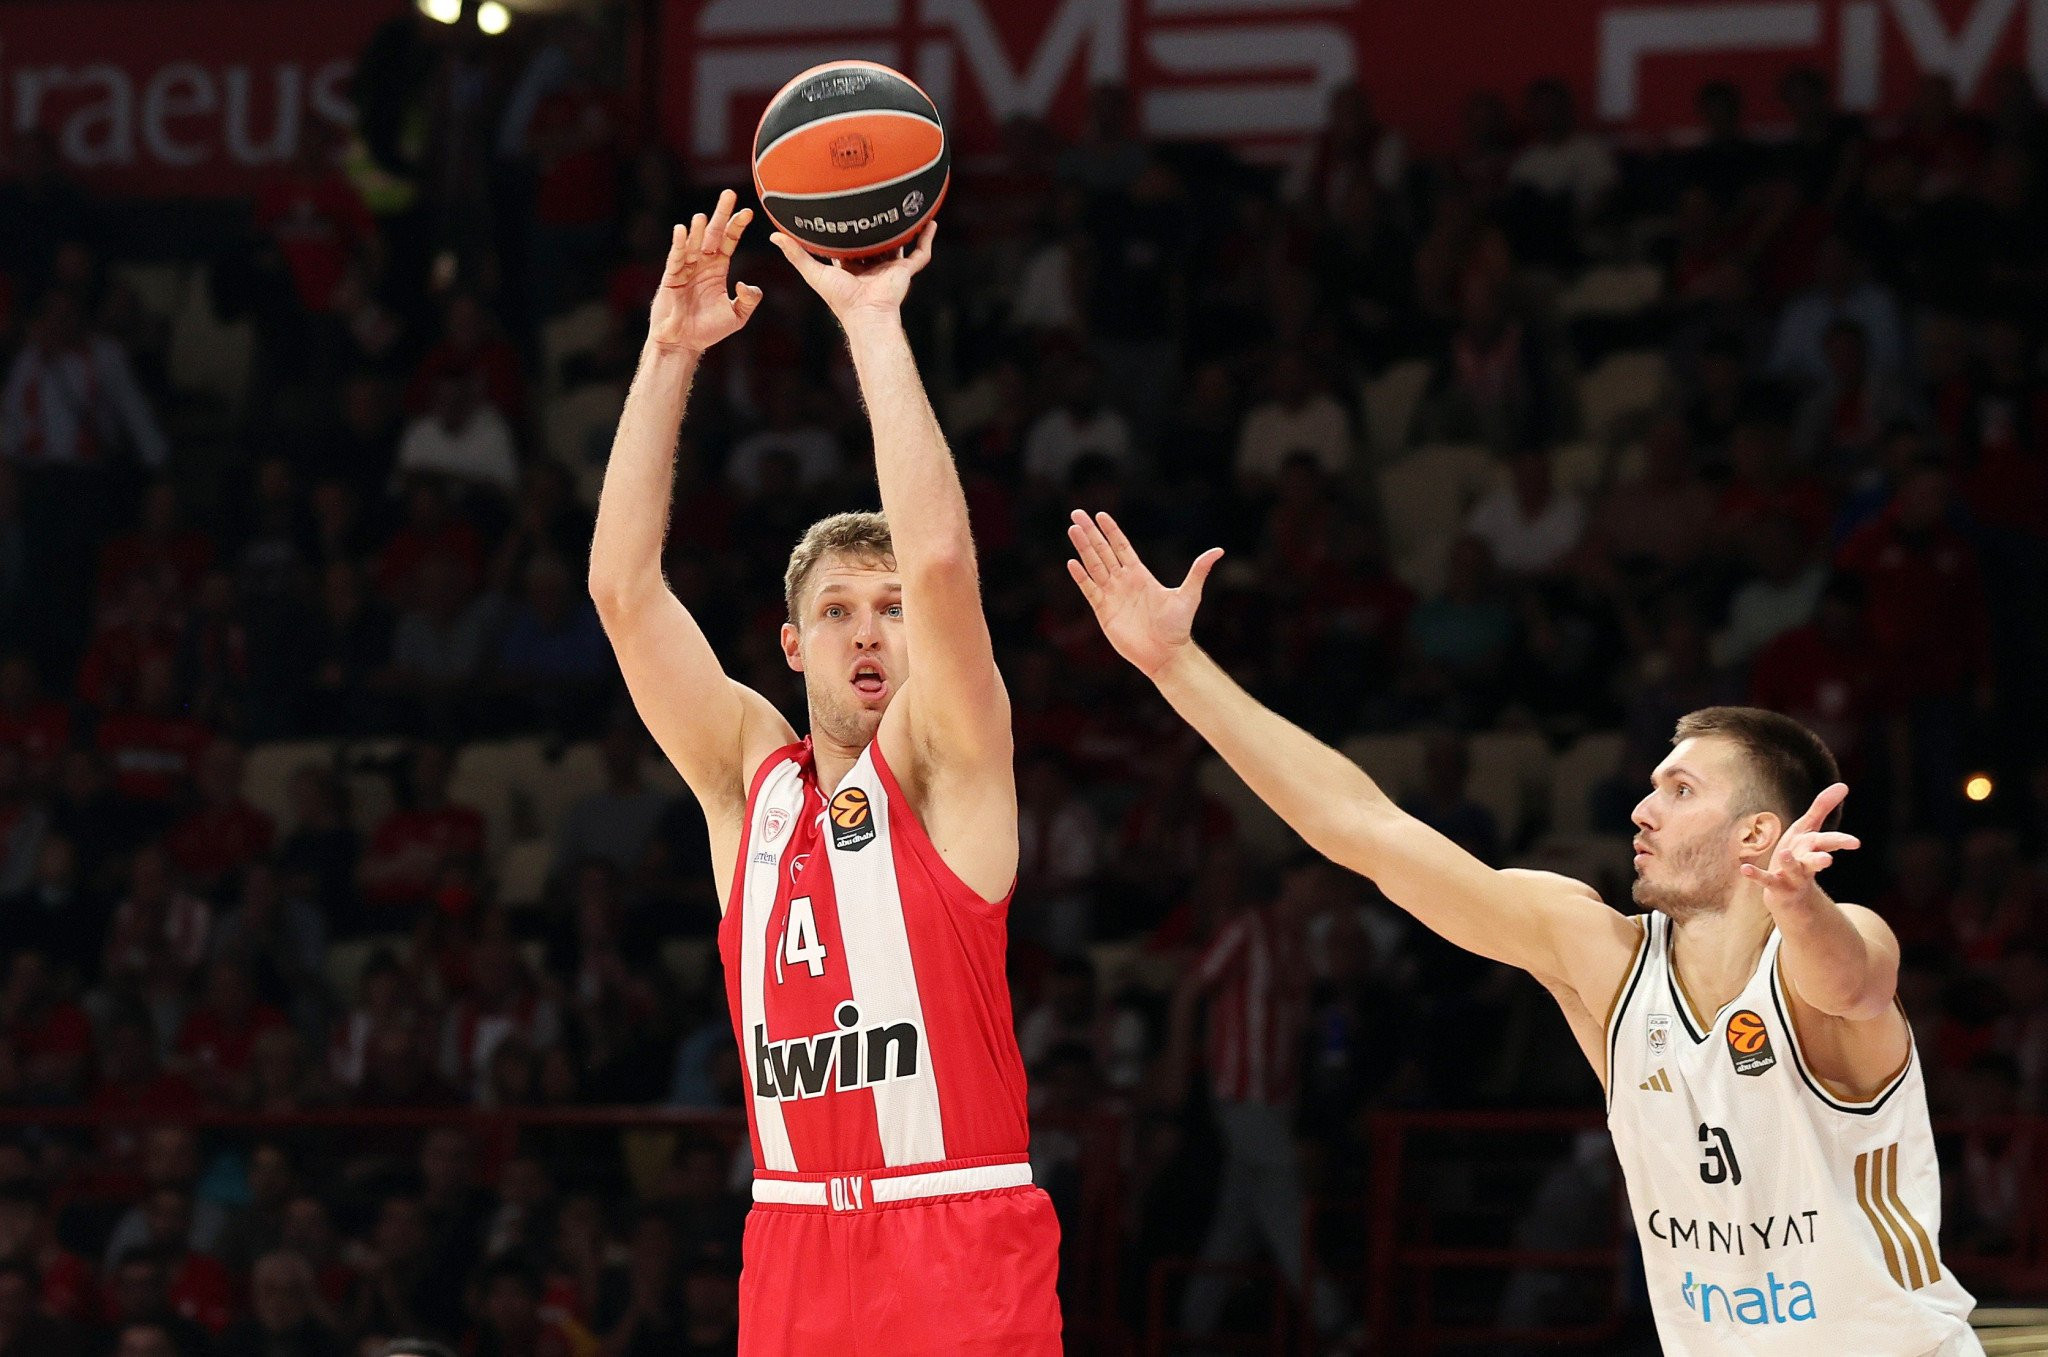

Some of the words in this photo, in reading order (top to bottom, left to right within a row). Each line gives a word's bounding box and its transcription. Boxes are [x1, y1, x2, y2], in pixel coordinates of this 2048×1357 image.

[775, 895, 828, 985] 4
[754, 1003, 919, 1099] bwin
[830, 1175, 863, 1212] OLY
